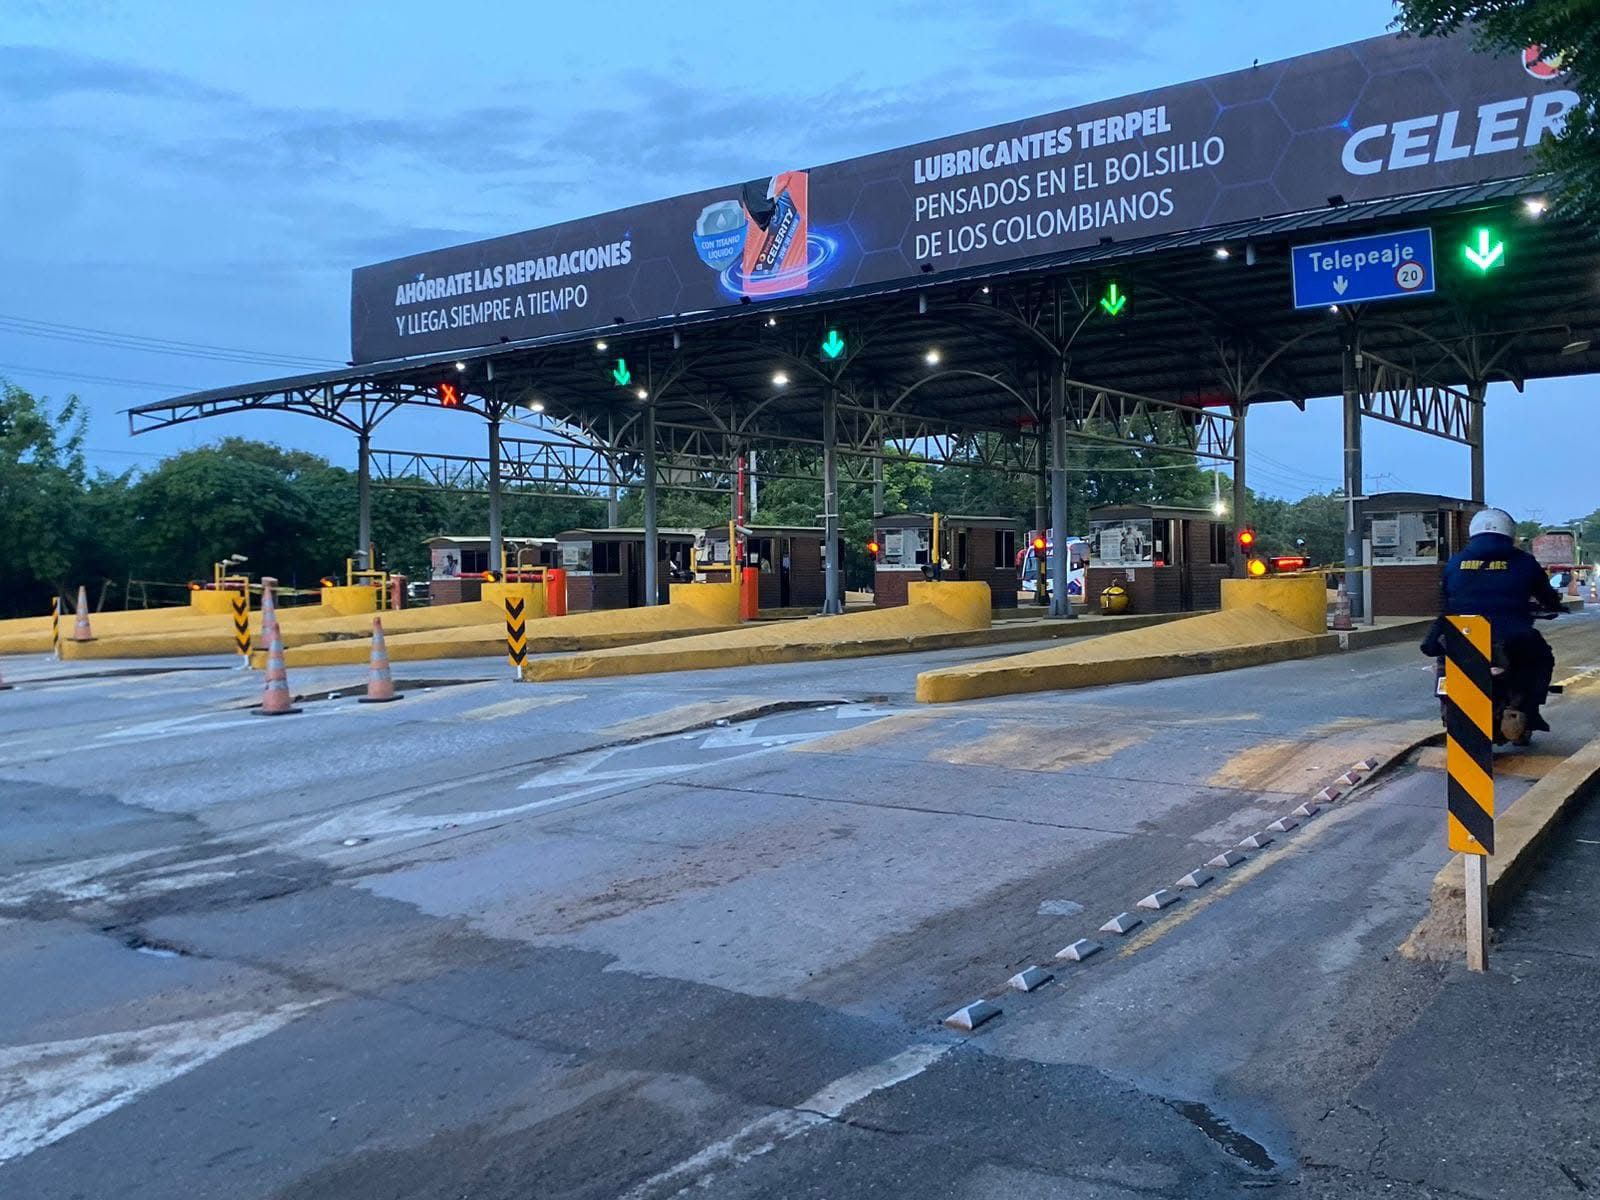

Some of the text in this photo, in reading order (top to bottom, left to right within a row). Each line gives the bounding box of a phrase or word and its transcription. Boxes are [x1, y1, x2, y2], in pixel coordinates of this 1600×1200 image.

[913, 105, 1172, 184] LUBRICANTES TERPEL
[1341, 90, 1586, 175] CELER
[915, 136, 1225, 222] PENSADOS EN EL BOLSILLO
[701, 234, 740, 250] CON TITANIO
[766, 207, 794, 265] CELERITY
[915, 187, 1174, 260] DE LOS COLOMBIANOS
[395, 240, 632, 306] AHÓRRATE LAS REPARACIONES
[1309, 243, 1414, 272] Telepeaje
[1402, 270, 1418, 282] 20
[395, 284, 588, 337] Y LLEGA SIEMPRE A TIEMPO
